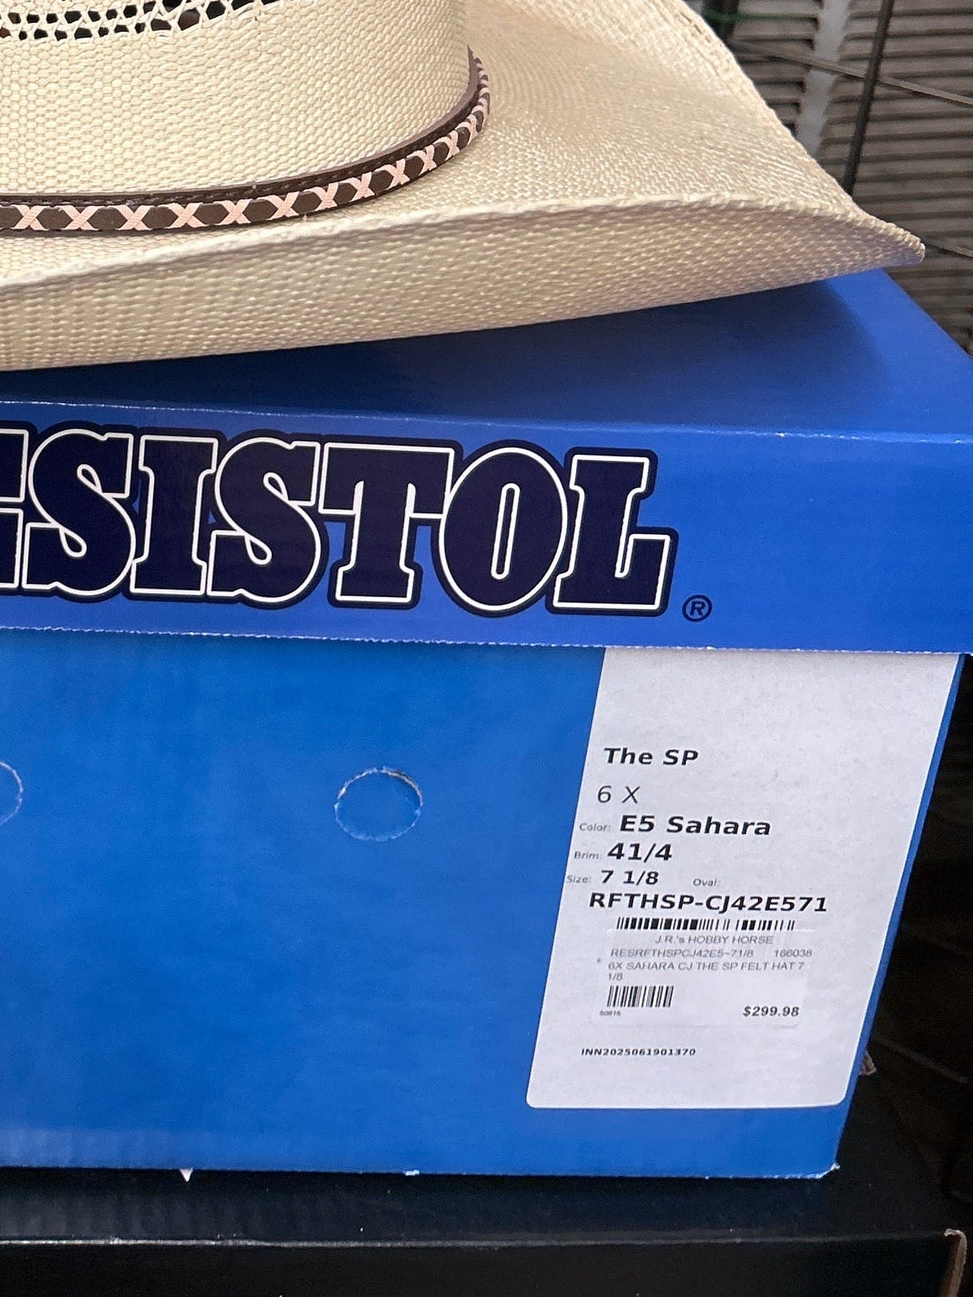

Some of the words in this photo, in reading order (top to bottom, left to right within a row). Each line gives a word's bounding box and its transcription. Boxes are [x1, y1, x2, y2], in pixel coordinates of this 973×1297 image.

[603, 747, 653, 765] The
[663, 749, 699, 766] SP
[597, 785, 612, 803] 6
[621, 785, 641, 804] X
[578, 823, 612, 832] Color:
[619, 815, 656, 833] E5
[666, 815, 772, 835] Sahara
[600, 870, 615, 884] 7
[622, 870, 660, 886] 1/8
[589, 892, 828, 914] RFTHSP-CJ42E571
[688, 935, 729, 944] HOBBY
[732, 935, 774, 944] HORSE
[608, 962, 623, 971] 6X
[626, 962, 675, 971] SAHARA
[678, 962, 693, 971] CJ
[696, 962, 719, 971] THE
[721, 962, 739, 971] SP
[740, 962, 769, 971] FELT
[771, 962, 795, 971] HAT
[743, 1005, 800, 1018] $299.98
